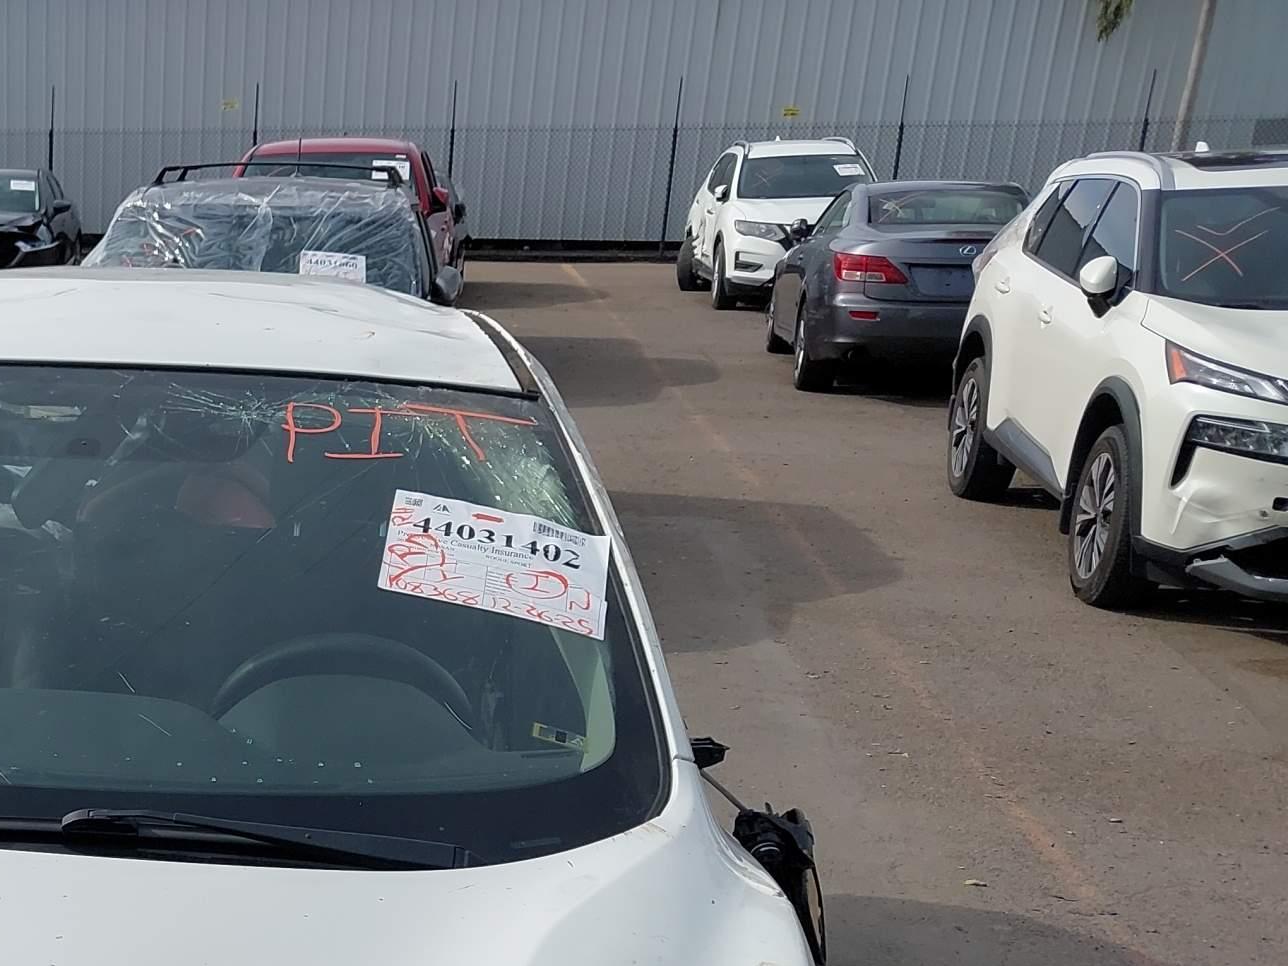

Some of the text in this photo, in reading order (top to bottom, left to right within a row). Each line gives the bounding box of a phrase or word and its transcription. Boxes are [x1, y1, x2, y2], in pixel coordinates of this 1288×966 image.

[281, 401, 539, 464] PIT
[413, 517, 581, 570] 44031402
[450, 540, 488, 554] Casualty
[491, 546, 534, 561] Insurance
